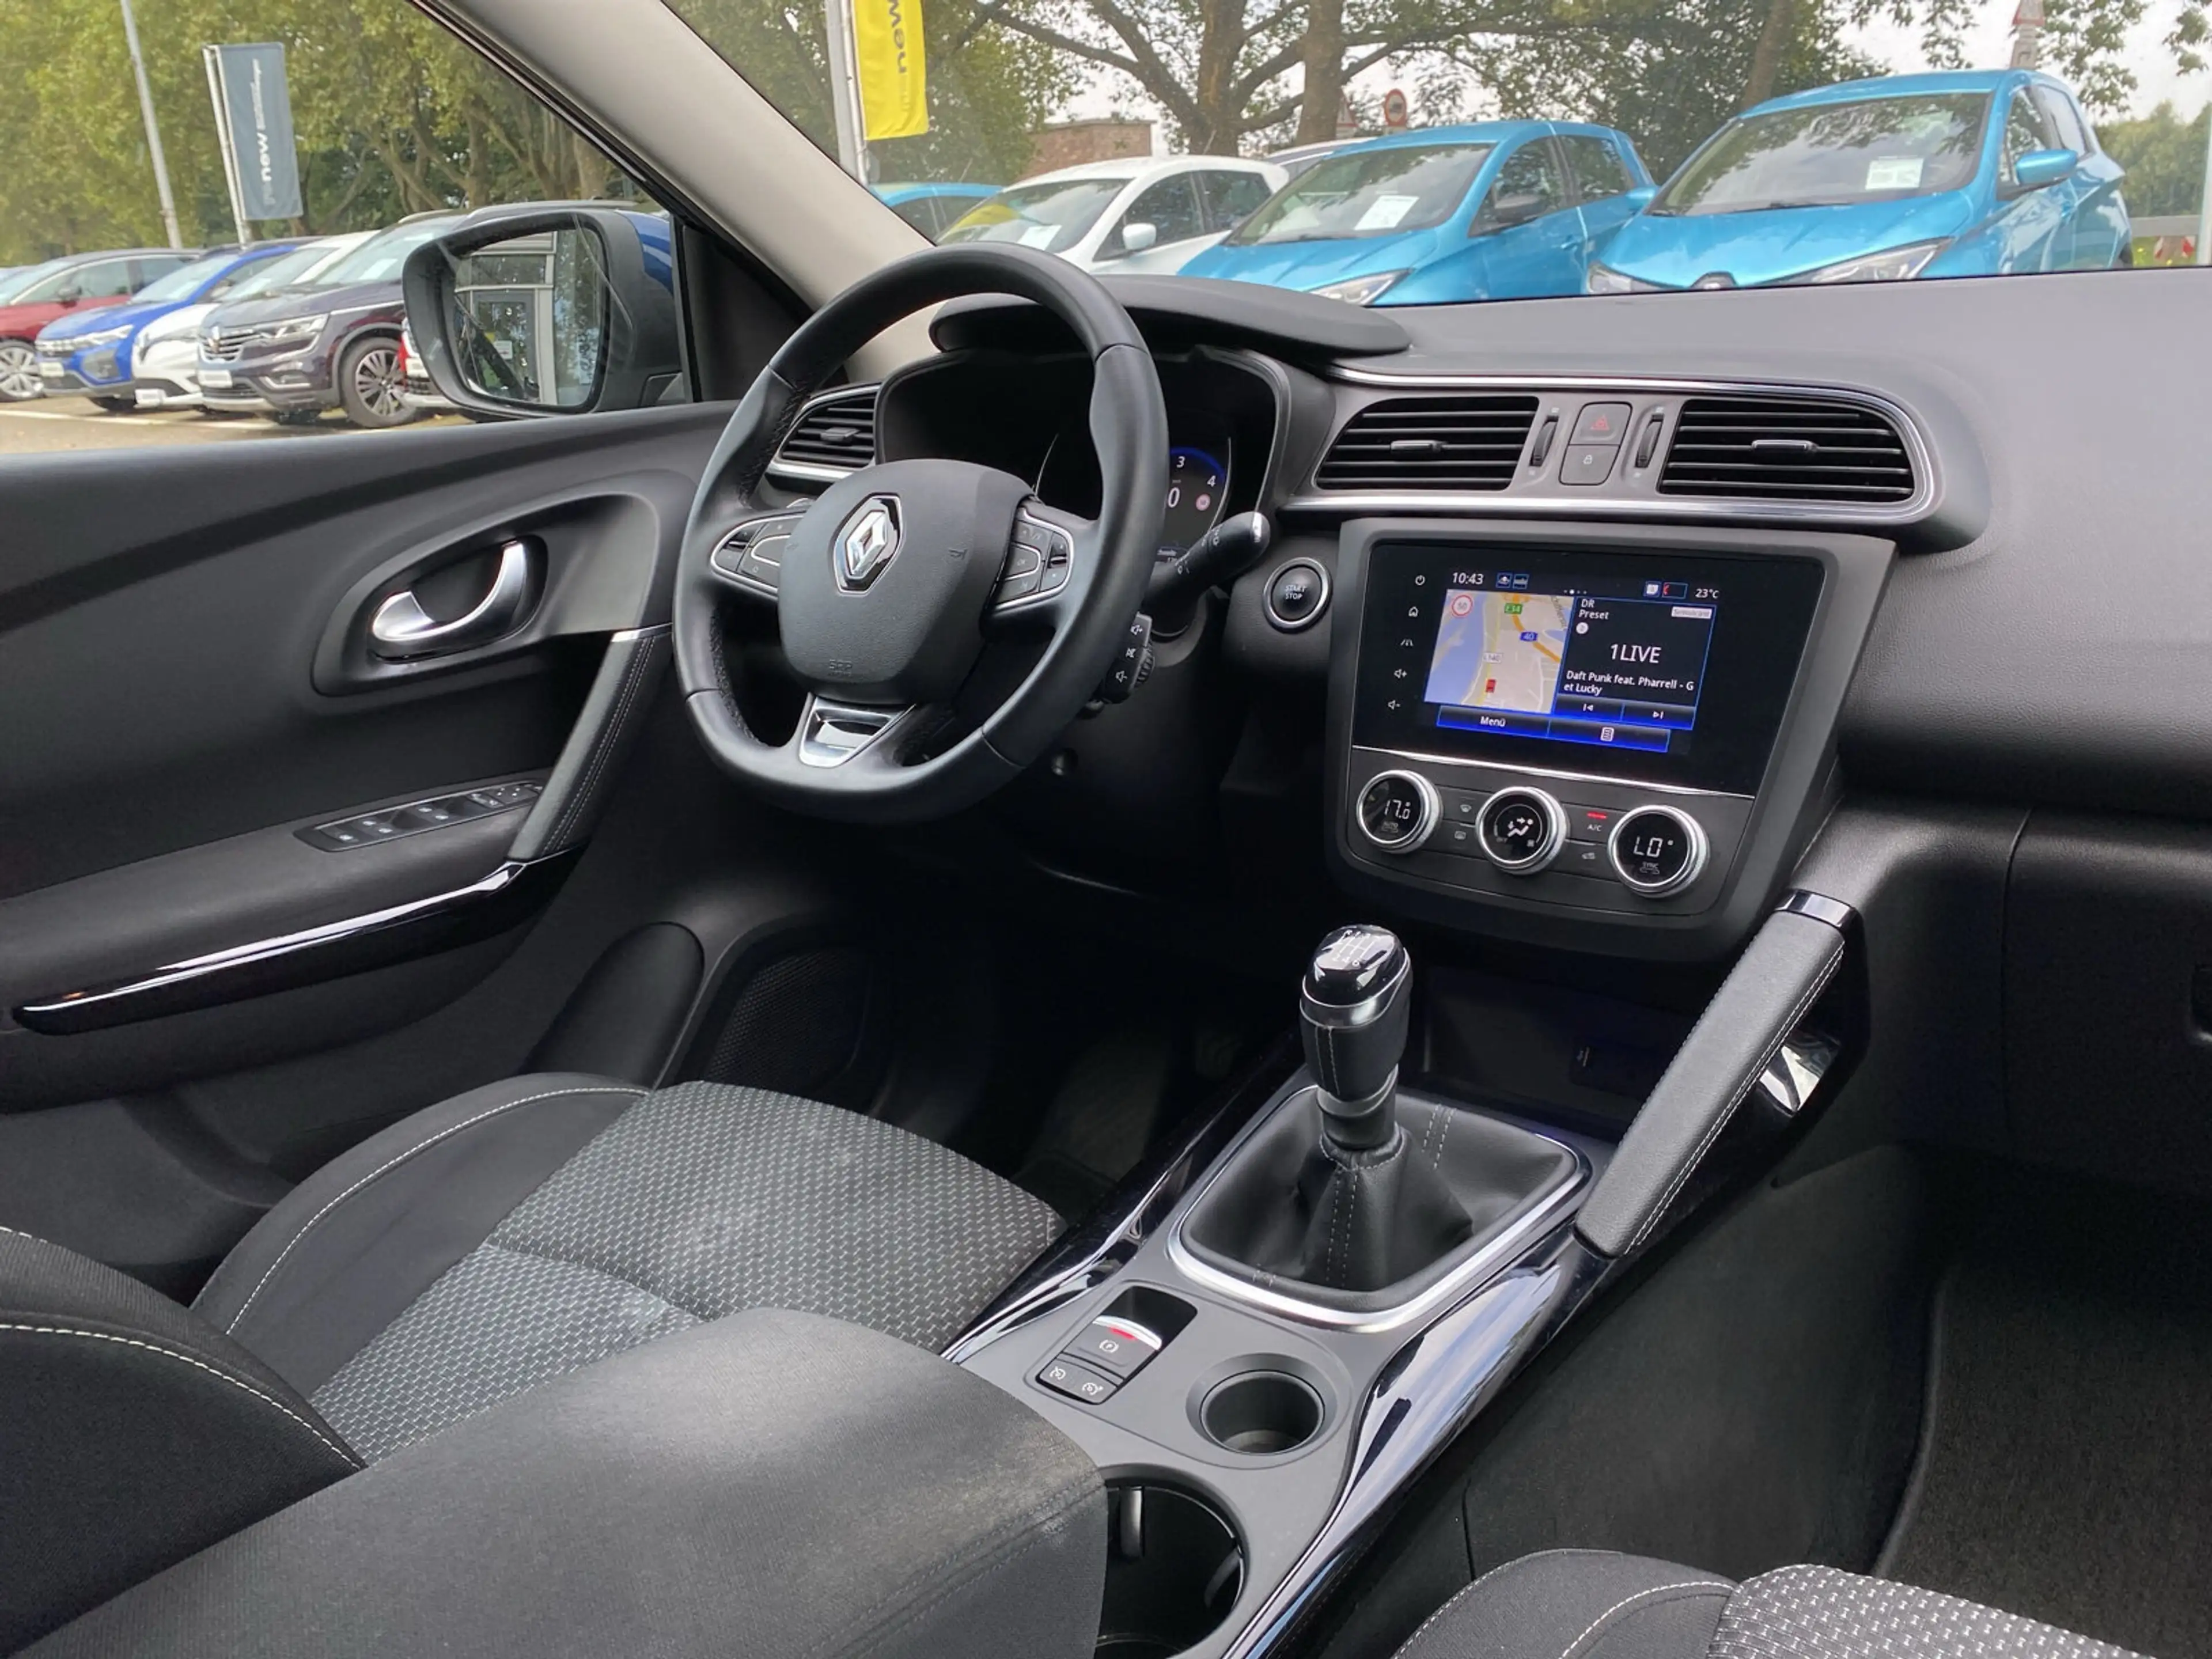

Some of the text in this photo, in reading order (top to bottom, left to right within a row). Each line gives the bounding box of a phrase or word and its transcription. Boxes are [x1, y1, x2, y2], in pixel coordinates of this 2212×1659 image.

[1176, 456, 1185, 468] 3
[1206, 475, 1217, 487] 4
[1452, 572, 1484, 585] 10:43
[1695, 588, 1719, 599] 23°C
[1581, 599, 1595, 608] DR
[1578, 608, 1609, 620] Preset
[1611, 643, 1661, 663] 1LIVE
[1566, 671, 1586, 680] Daft
[1588, 672, 1612, 683] Punk
[1613, 674, 1635, 685] feat.
[1638, 677, 1677, 690] Pharrell
[1685, 681, 1695, 691] G
[1575, 684, 1603, 696] Lucky
